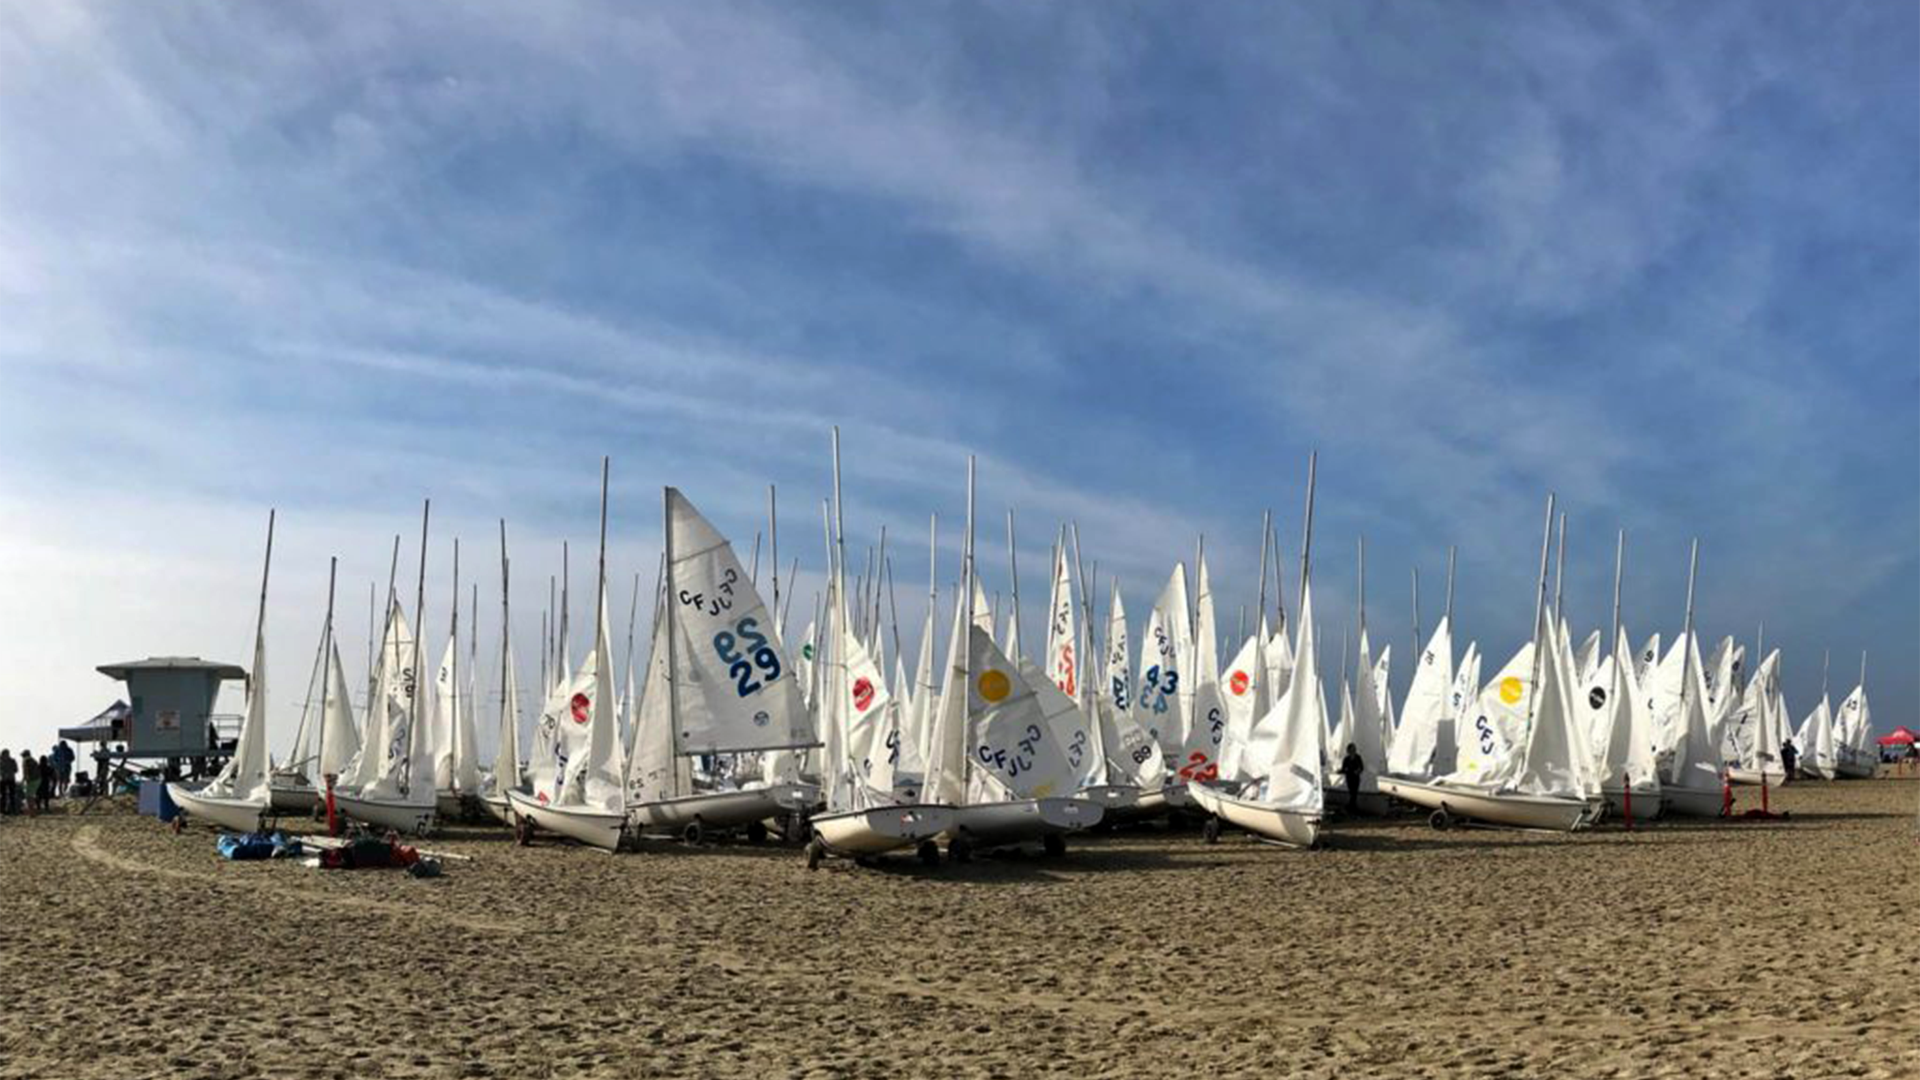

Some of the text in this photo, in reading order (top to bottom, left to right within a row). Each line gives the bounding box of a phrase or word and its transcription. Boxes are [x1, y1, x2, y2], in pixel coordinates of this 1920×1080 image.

[679, 590, 720, 616] CFJ
[729, 647, 781, 698] 29
[1146, 664, 1179, 695] 43
[1208, 708, 1223, 745] CFJ
[1476, 715, 1494, 755] CFJ
[979, 745, 1017, 777] CFJ
